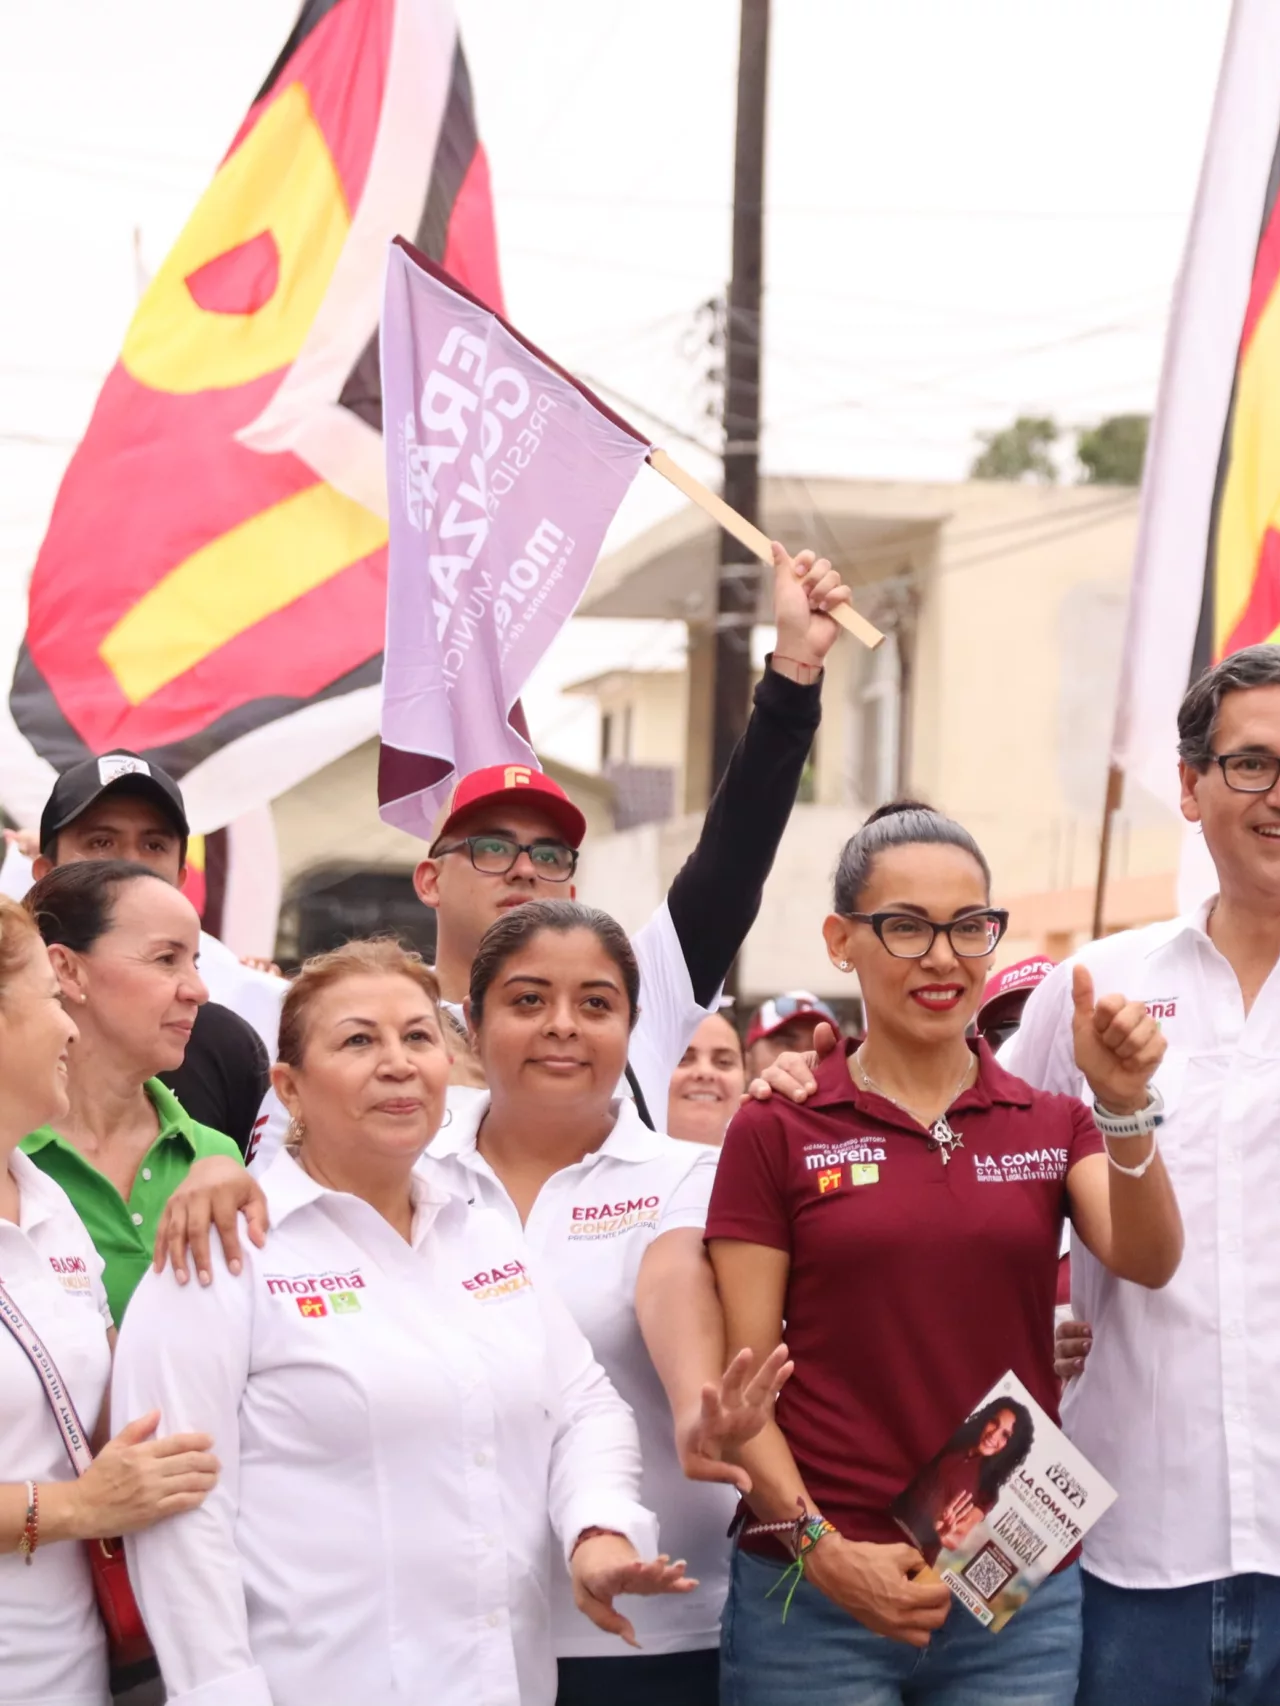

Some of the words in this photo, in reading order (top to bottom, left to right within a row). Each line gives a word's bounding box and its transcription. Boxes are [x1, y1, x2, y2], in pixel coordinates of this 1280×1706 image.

[805, 1147, 887, 1170] morena
[974, 1154, 996, 1167] LA
[1001, 1148, 1068, 1166] COMAYE
[976, 1165, 1031, 1175] CYNTHIA
[820, 1173, 841, 1193] PT
[572, 1196, 660, 1220] ERASMO
[266, 1275, 366, 1295] morena
[301, 1303, 322, 1316] PT
[31, 1343, 63, 1400] HILFIGER
[60, 1407, 82, 1453] TOMMY
[1044, 1465, 1087, 1509] VOTA
[1018, 1469, 1037, 1488] LA
[1032, 1485, 1084, 1538] COMAYE
[943, 1574, 977, 1609] morena
